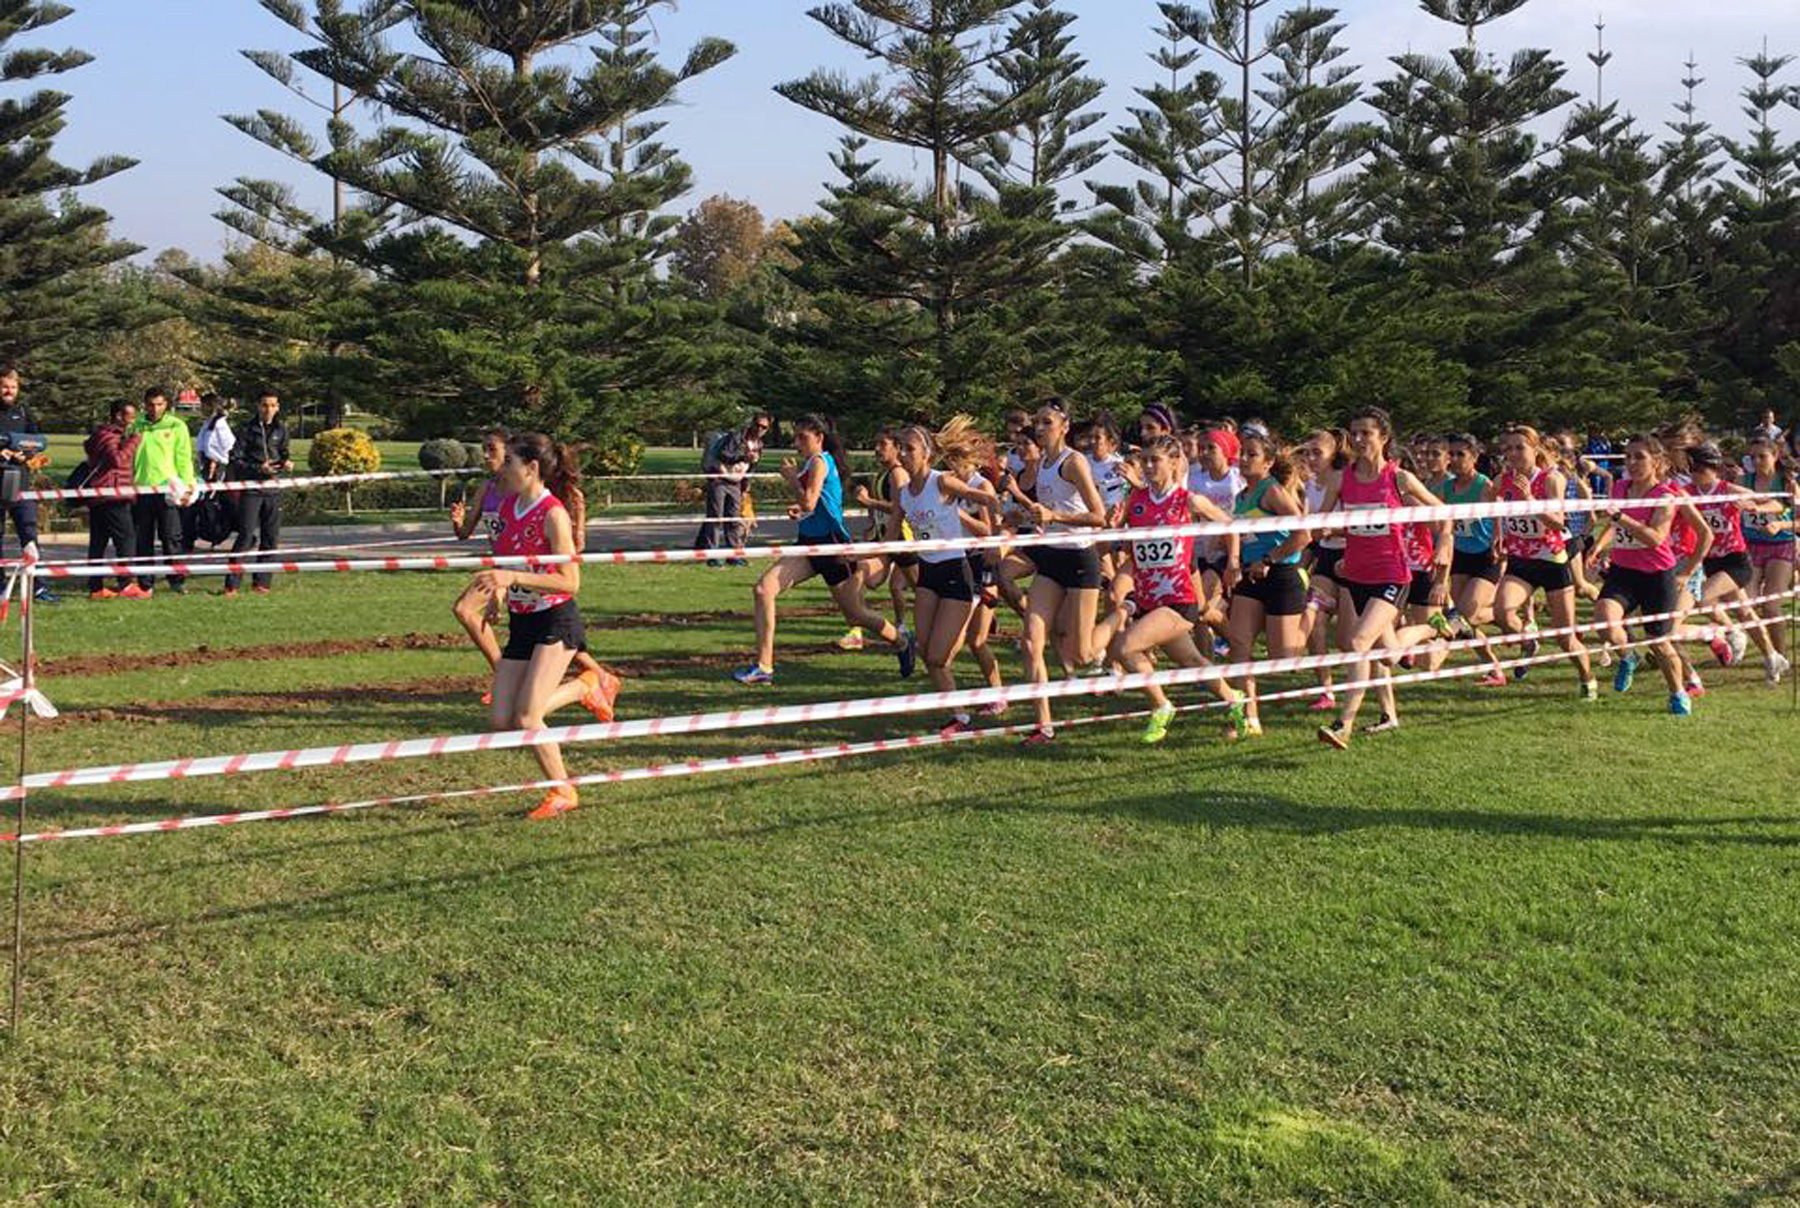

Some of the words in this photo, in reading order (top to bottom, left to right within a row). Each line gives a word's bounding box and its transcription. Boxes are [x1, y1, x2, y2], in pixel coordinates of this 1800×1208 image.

[1507, 516, 1539, 534] 331
[1136, 541, 1174, 562] 332
[1384, 584, 1398, 601] 2
